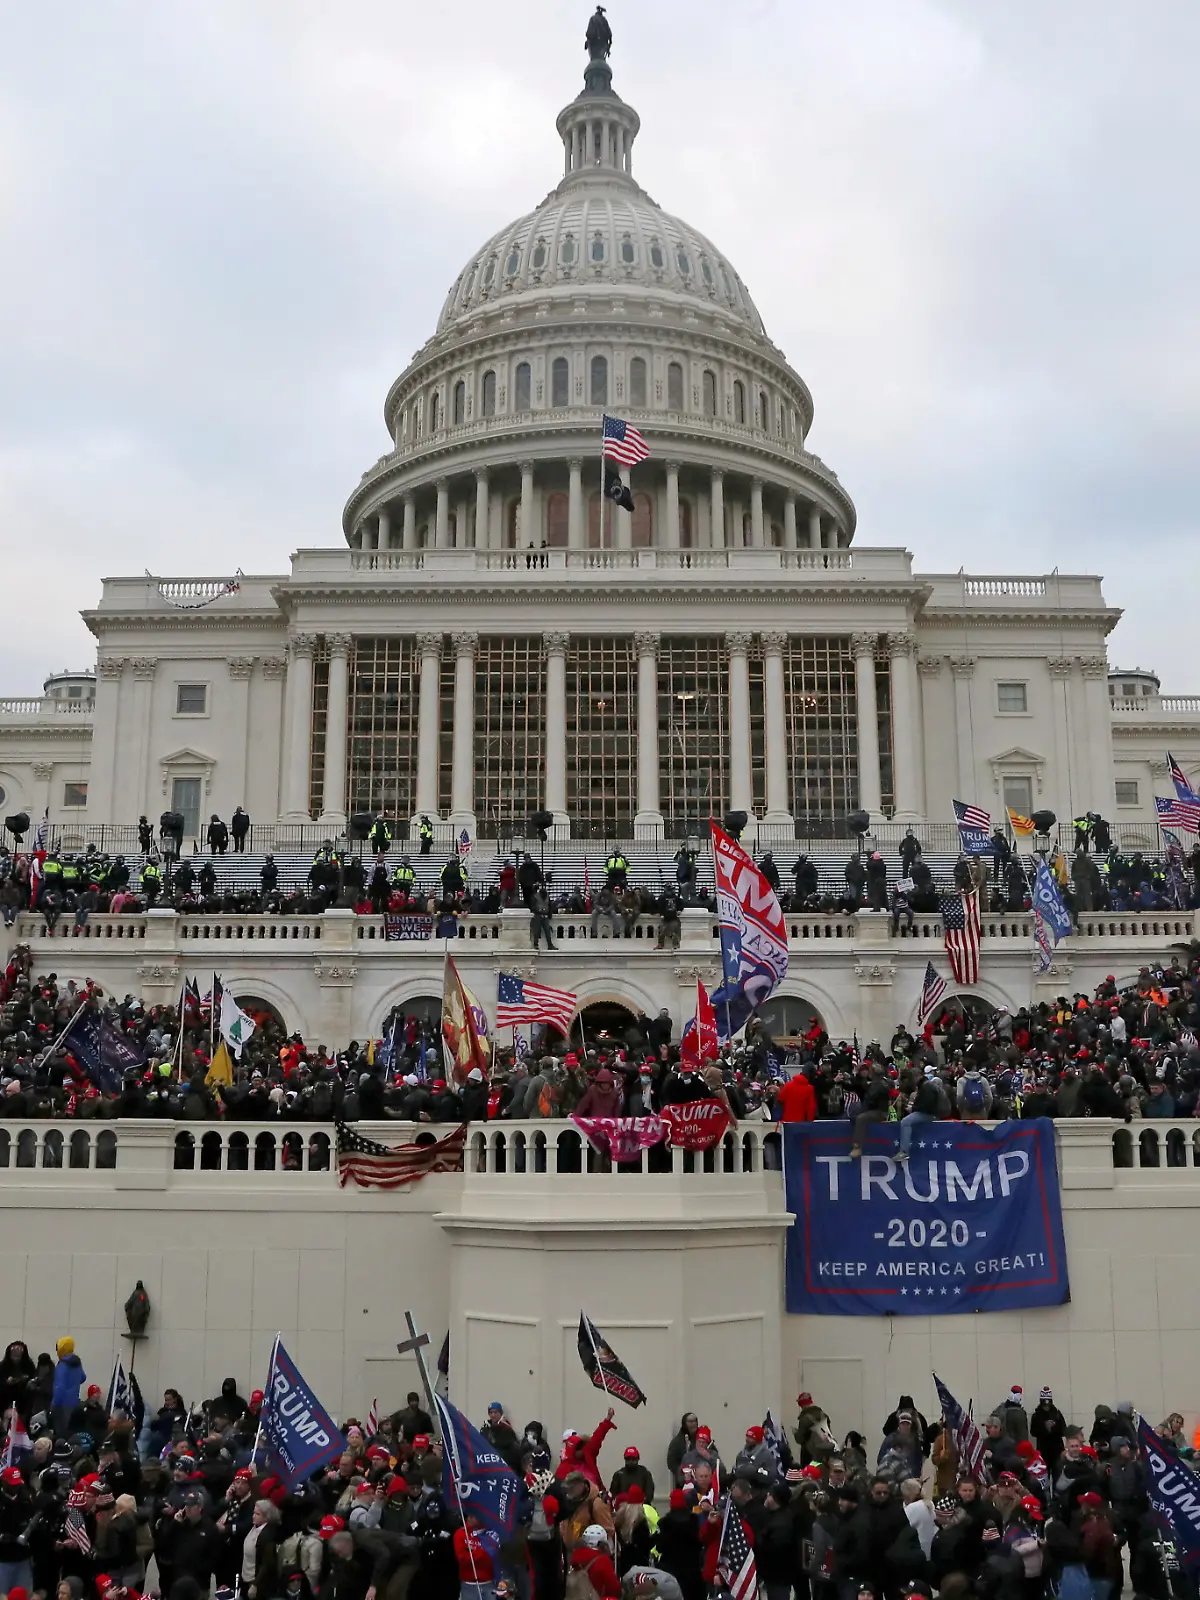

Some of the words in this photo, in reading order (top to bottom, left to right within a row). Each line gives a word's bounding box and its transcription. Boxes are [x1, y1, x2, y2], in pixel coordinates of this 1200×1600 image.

[387, 916, 432, 924] UNITED
[400, 923, 421, 931] WE
[815, 1150, 1030, 1203] TRUMP
[873, 1218, 987, 1247] -2020-
[819, 1262, 868, 1276] KEEP
[875, 1262, 966, 1276] AMERICA
[974, 1252, 1045, 1274] GREAT!
